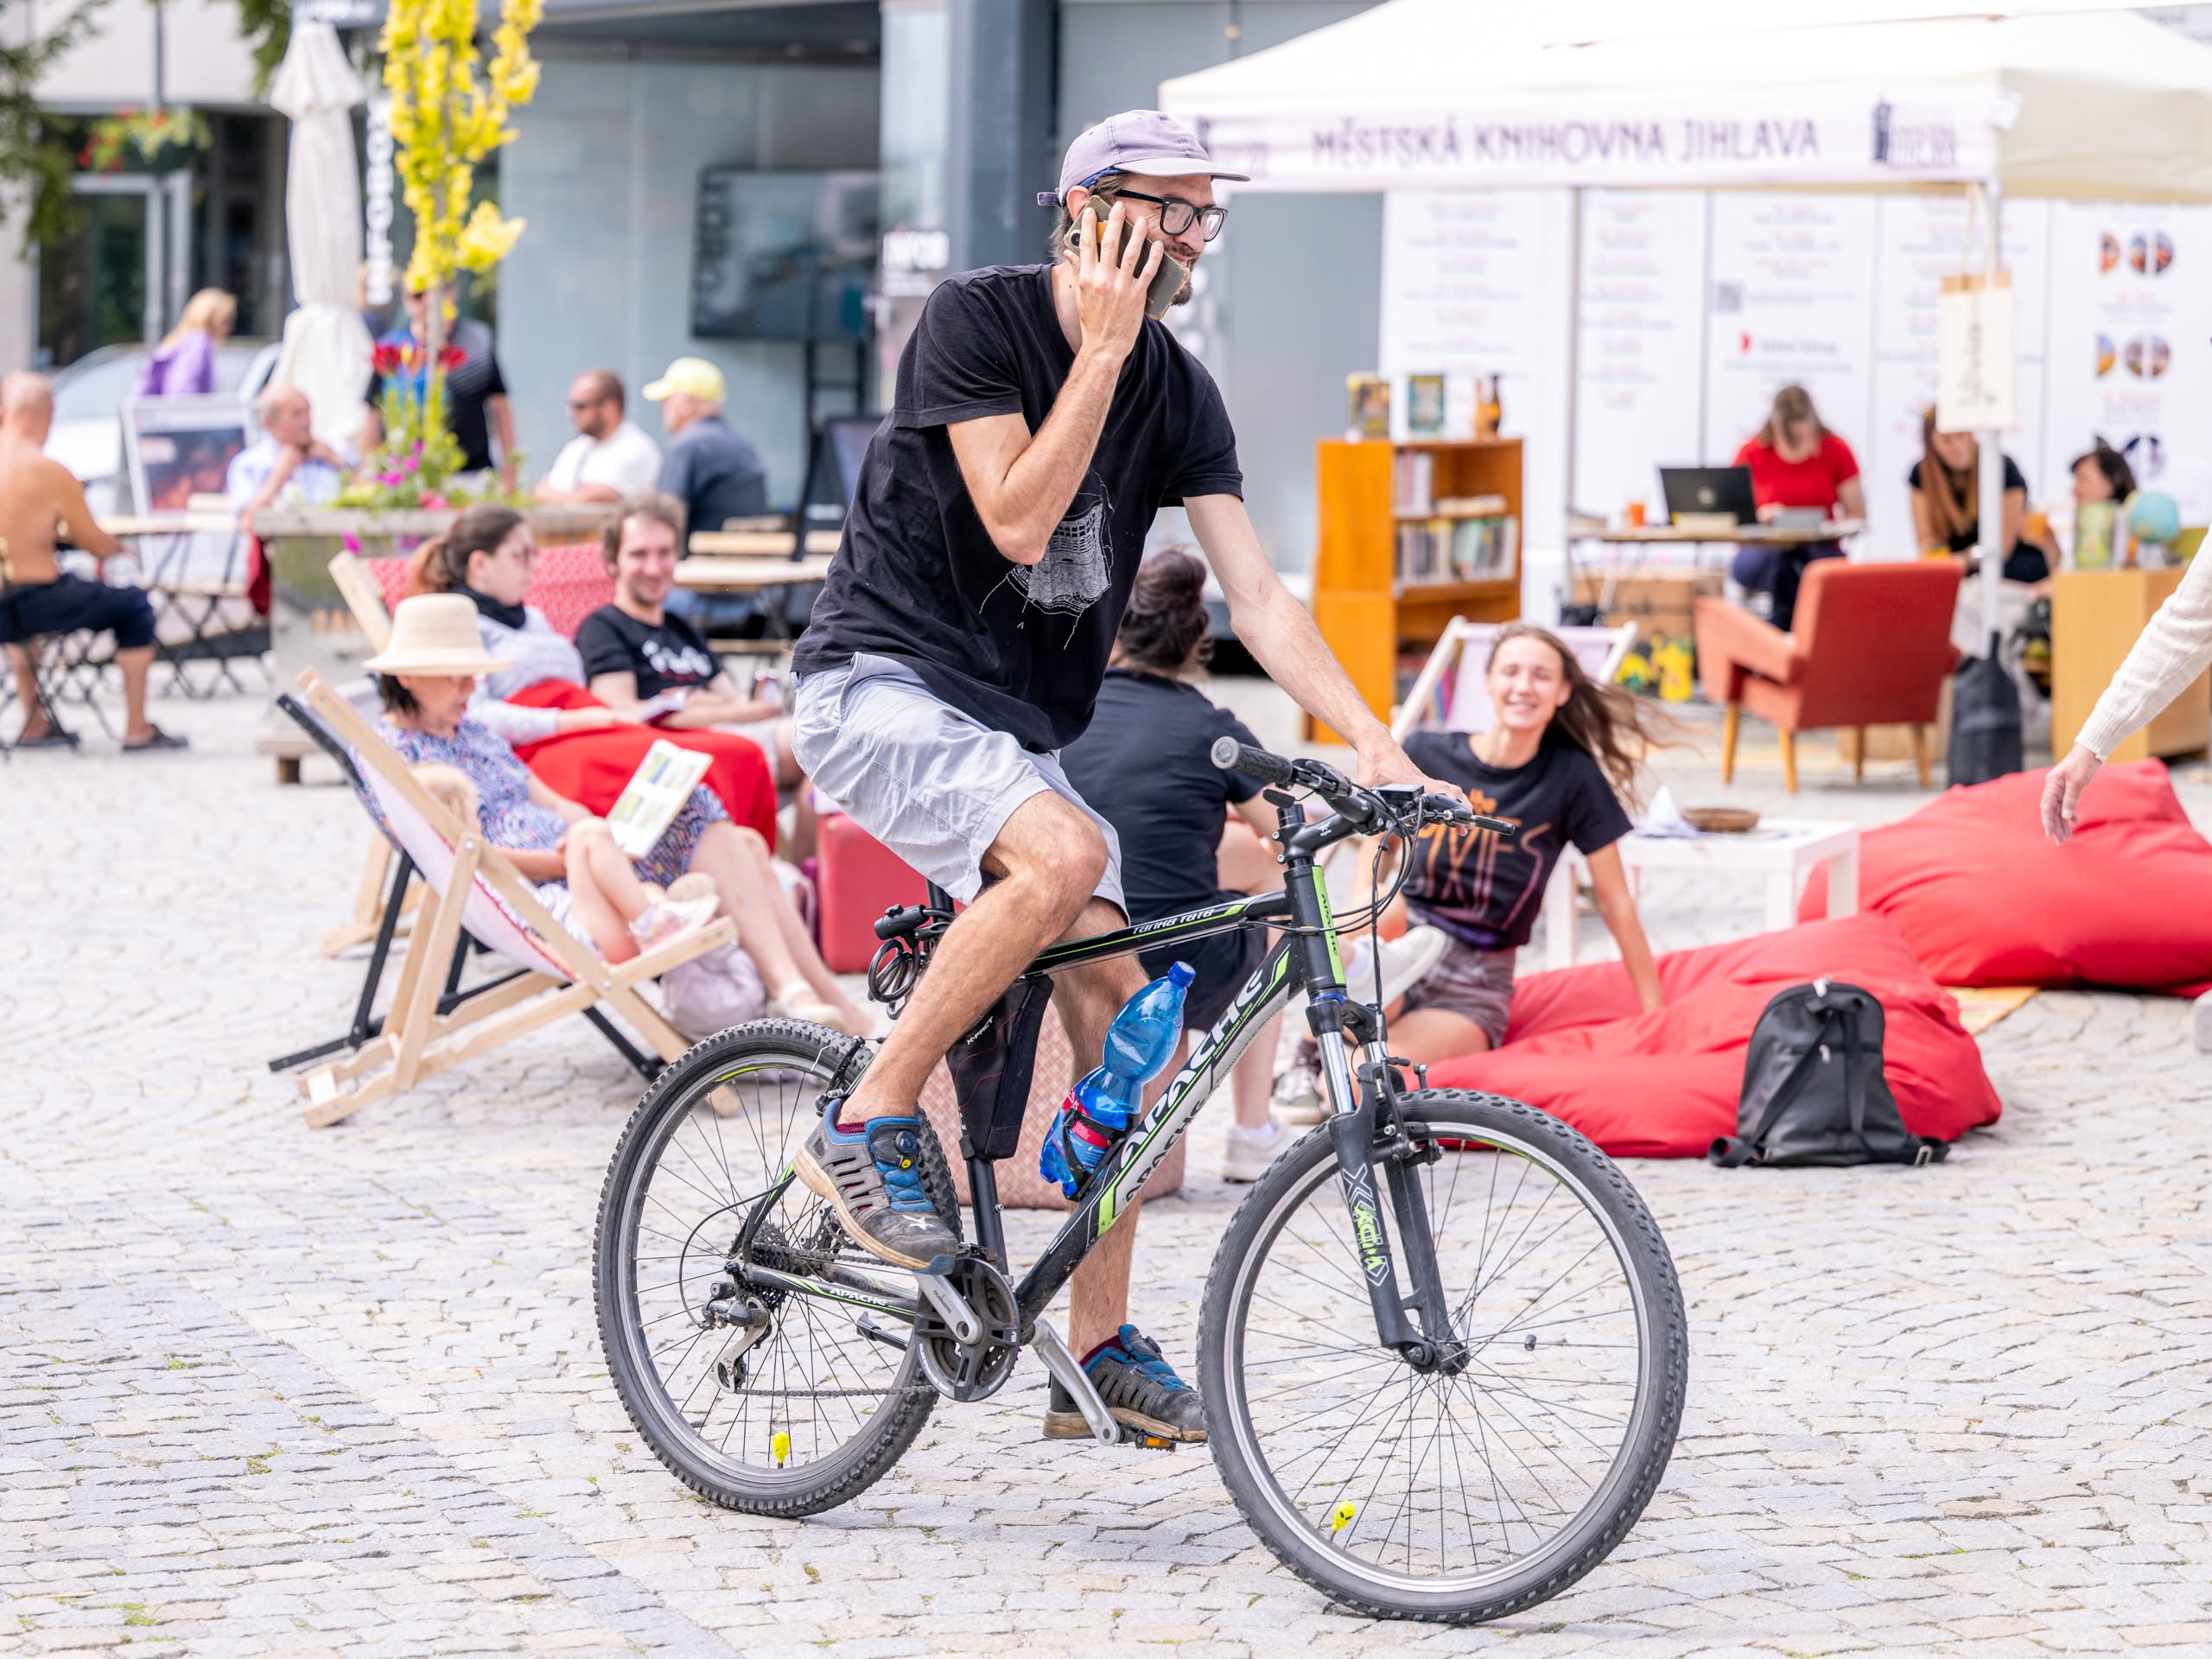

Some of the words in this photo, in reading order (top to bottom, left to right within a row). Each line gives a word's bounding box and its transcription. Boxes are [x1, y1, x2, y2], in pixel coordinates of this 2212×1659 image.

[1312, 115, 1463, 168] MĚSTSKÁ
[1473, 121, 1665, 164] KNIHOVNA
[1681, 118, 1820, 162] JIHLAVA
[966, 1016, 994, 1046] X-FACT
[1121, 969, 1263, 1169] APACHE
[1126, 1097, 1207, 1203] APACHE
[829, 1287, 888, 1306] APACHE
